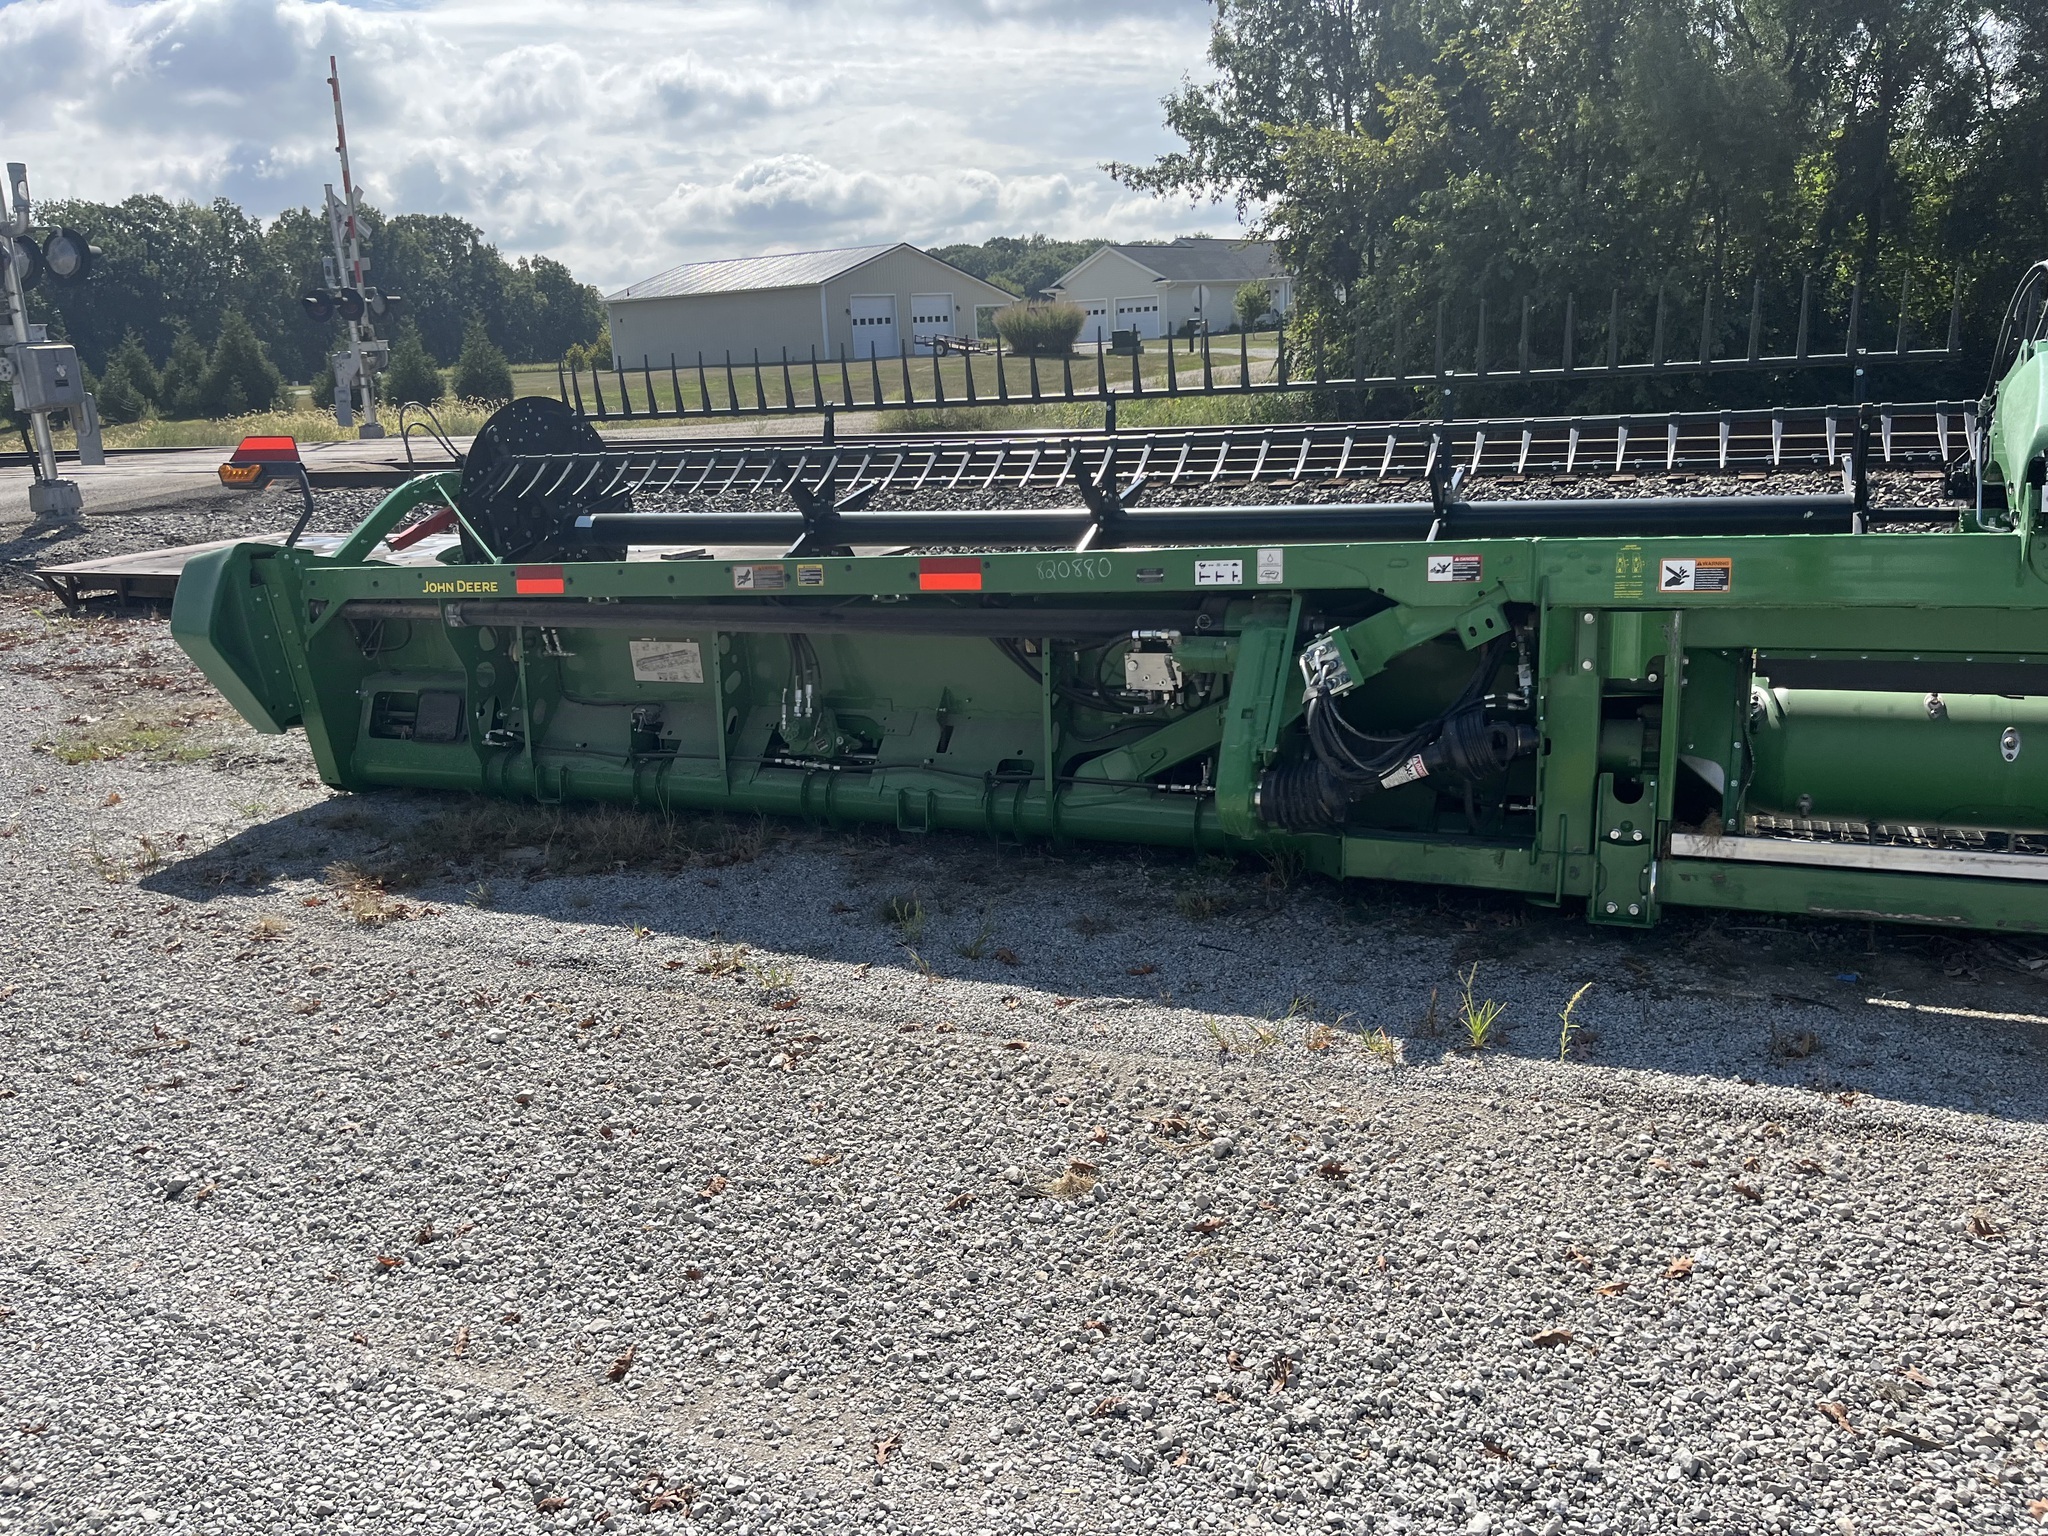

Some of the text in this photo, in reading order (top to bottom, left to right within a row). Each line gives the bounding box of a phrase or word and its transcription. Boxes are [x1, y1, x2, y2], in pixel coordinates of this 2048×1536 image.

[1036, 557, 1112, 579] 820880
[422, 580, 499, 593] JOHN DEERE
